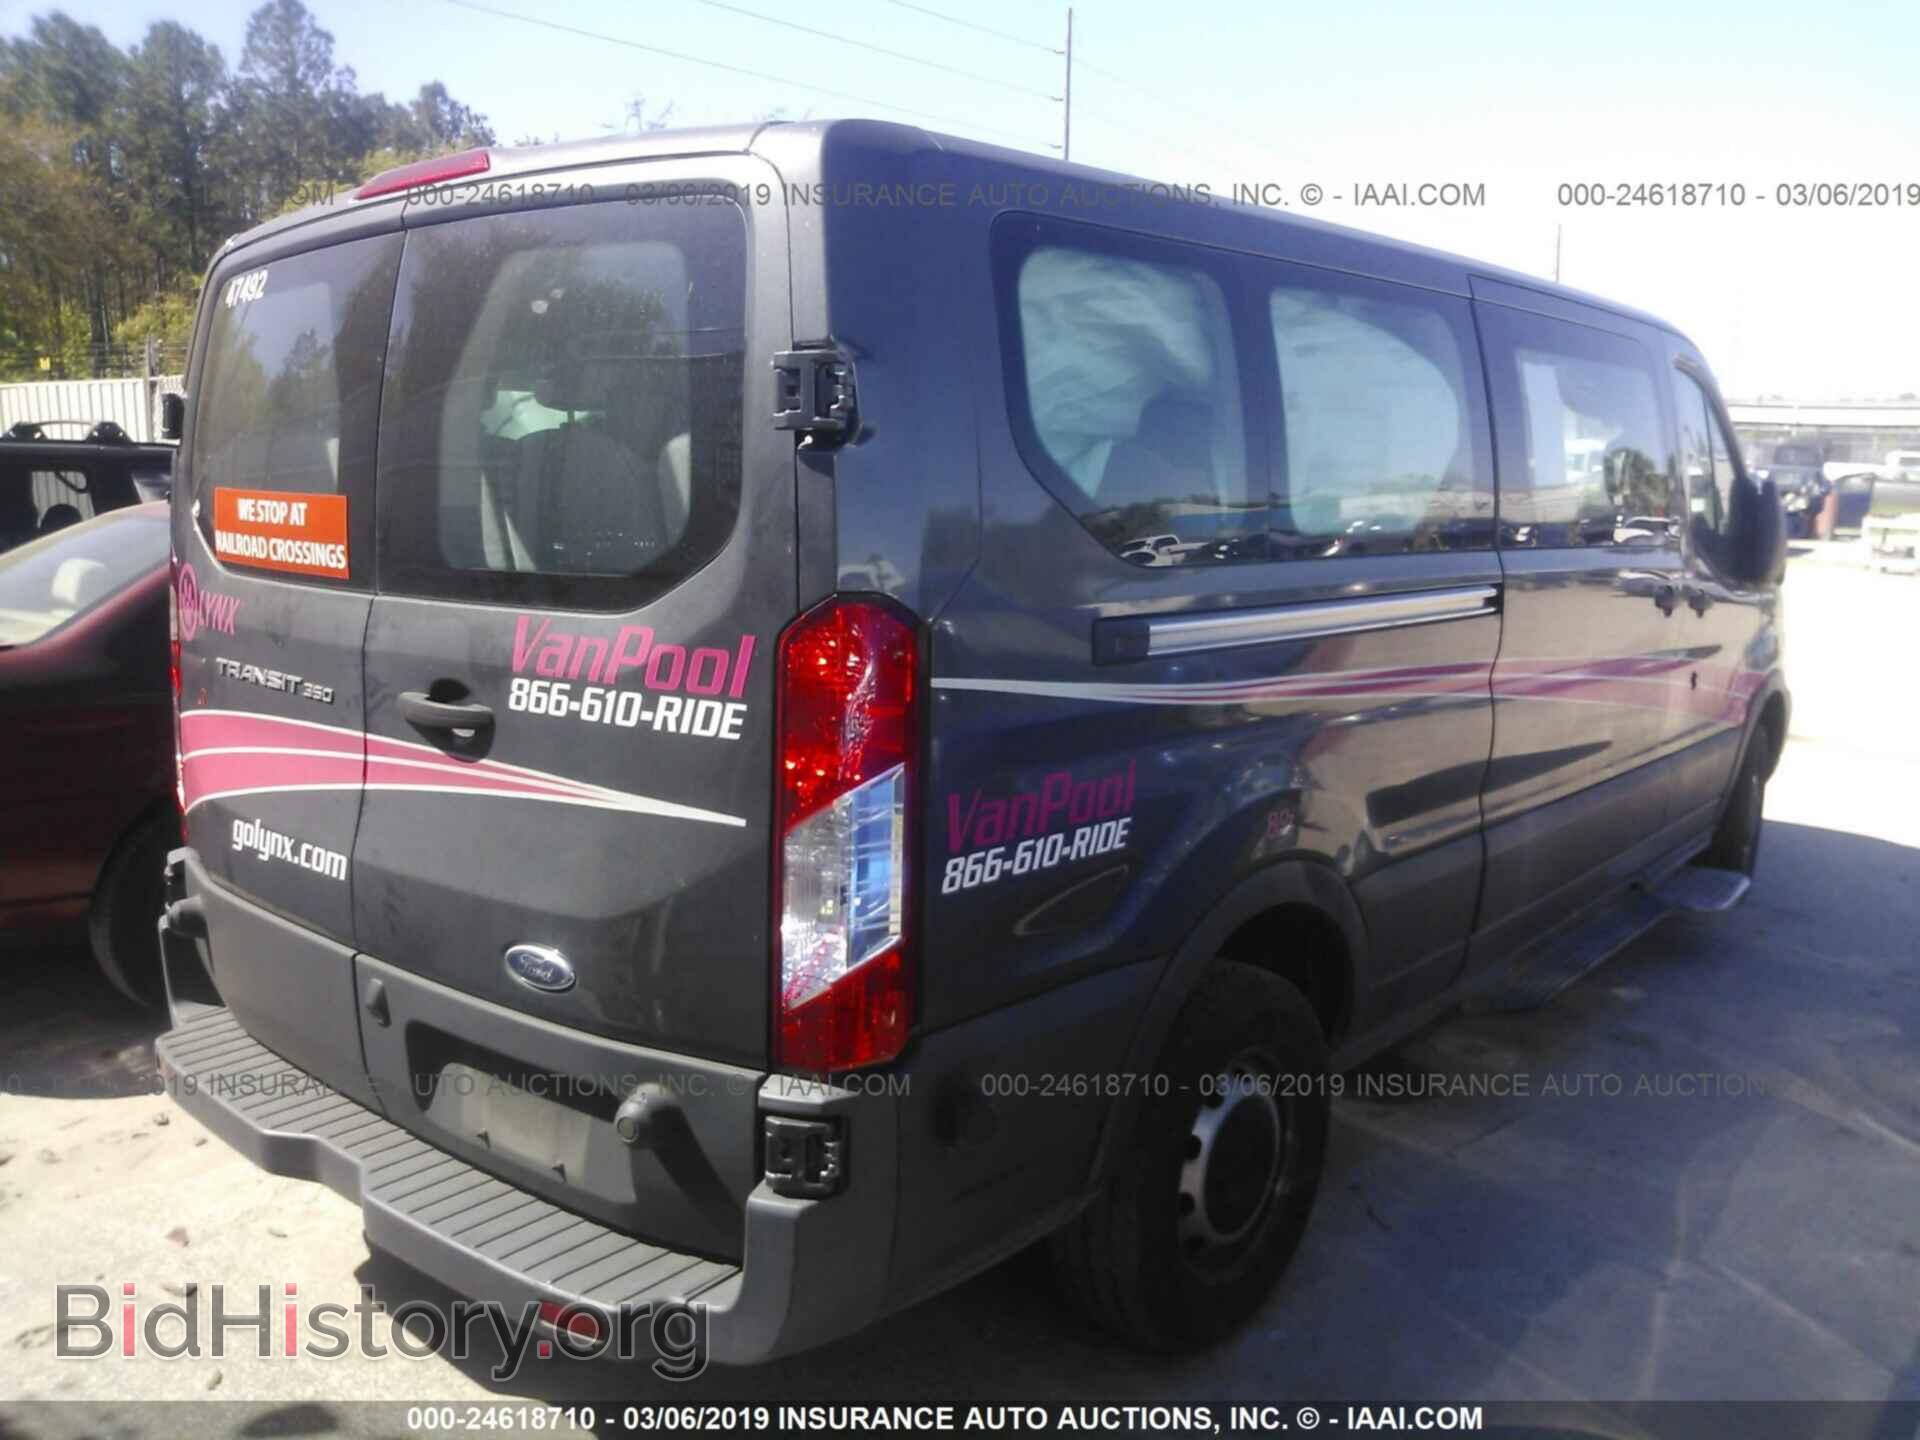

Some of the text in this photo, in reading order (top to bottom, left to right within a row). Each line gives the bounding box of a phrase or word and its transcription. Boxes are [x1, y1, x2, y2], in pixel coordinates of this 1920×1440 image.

[237, 498, 308, 527] WE STOP AT
[268, 537, 347, 570] CROSSINGS
[199, 589, 241, 636] LYNX
[215, 656, 335, 704] TRANSIT 350
[512, 613, 756, 699] VanPool
[508, 677, 748, 741] 866-610-RIDE
[946, 756, 1137, 855] VanPool
[231, 818, 348, 881] golynx.com
[940, 816, 1132, 895] 866-610-RIDE
